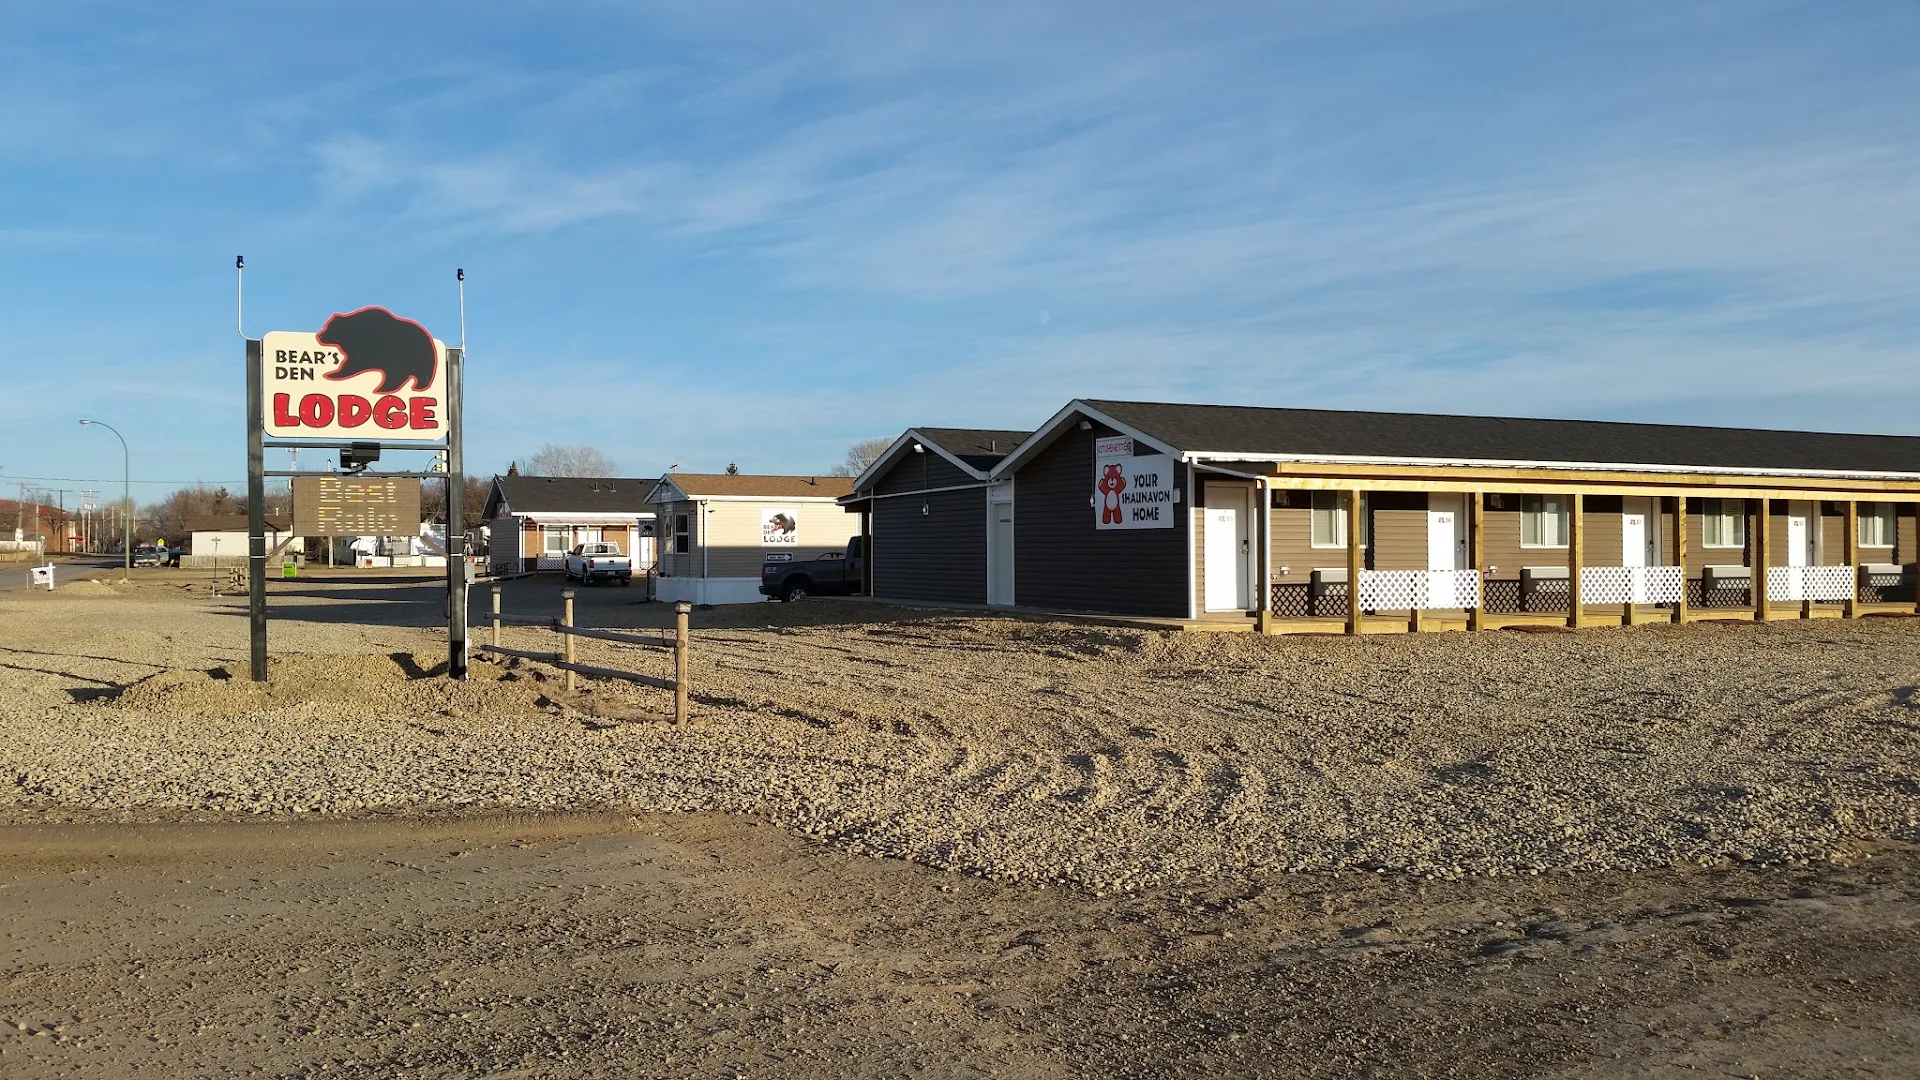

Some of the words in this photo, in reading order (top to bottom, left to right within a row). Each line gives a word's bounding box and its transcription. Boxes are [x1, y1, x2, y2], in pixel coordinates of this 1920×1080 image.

[275, 349, 340, 365] BEAR'S
[275, 367, 314, 380] DEN
[273, 392, 439, 430] LODGE
[1133, 473, 1158, 488] YOUR
[320, 477, 397, 503] Best
[1122, 490, 1170, 504] SHAUNAVON
[1132, 506, 1159, 521] HOME
[763, 535, 796, 543] LODGE
